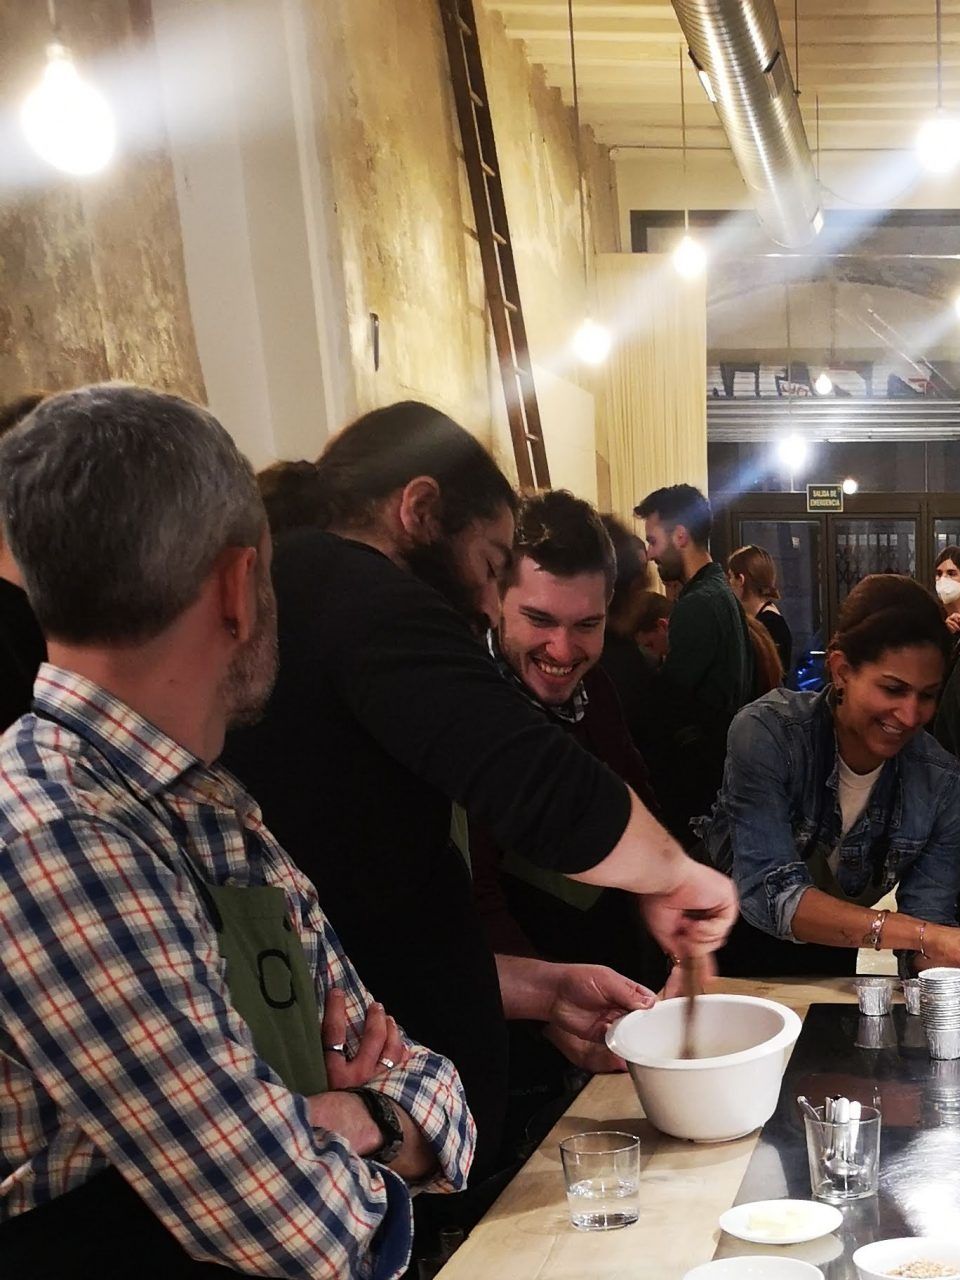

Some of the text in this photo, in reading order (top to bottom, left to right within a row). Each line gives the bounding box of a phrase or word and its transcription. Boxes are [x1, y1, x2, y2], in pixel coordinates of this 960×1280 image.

[813, 490, 838, 498] SALIDA DE
[810, 498, 840, 507] EMERGENCIA
